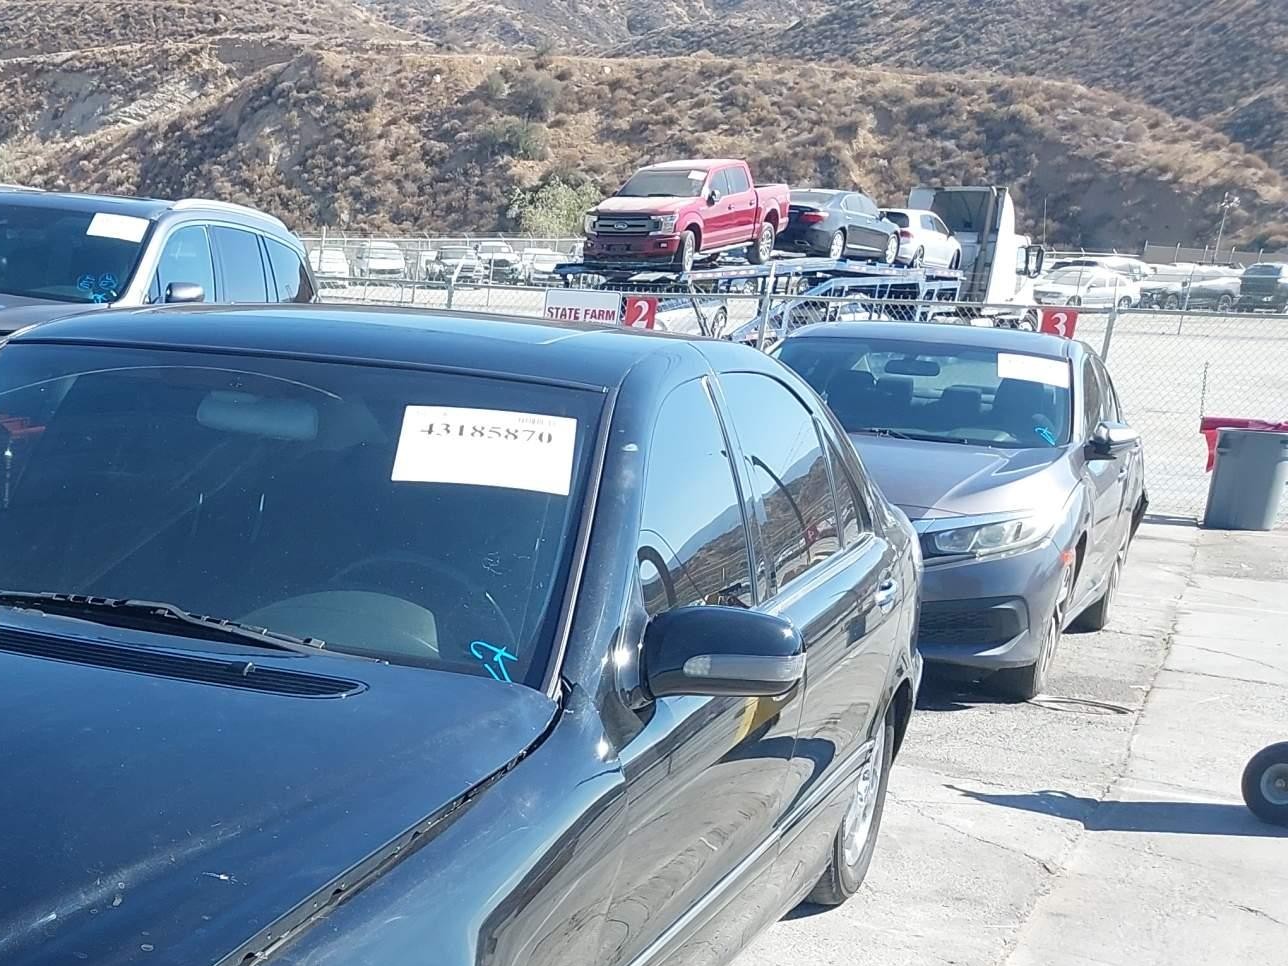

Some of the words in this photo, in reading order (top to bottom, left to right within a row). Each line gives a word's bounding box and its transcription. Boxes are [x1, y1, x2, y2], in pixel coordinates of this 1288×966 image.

[547, 306, 581, 321] STATE
[583, 308, 616, 321] FARM
[632, 300, 650, 328] 2
[1051, 312, 1068, 336] 3
[420, 422, 553, 444] 43185870
